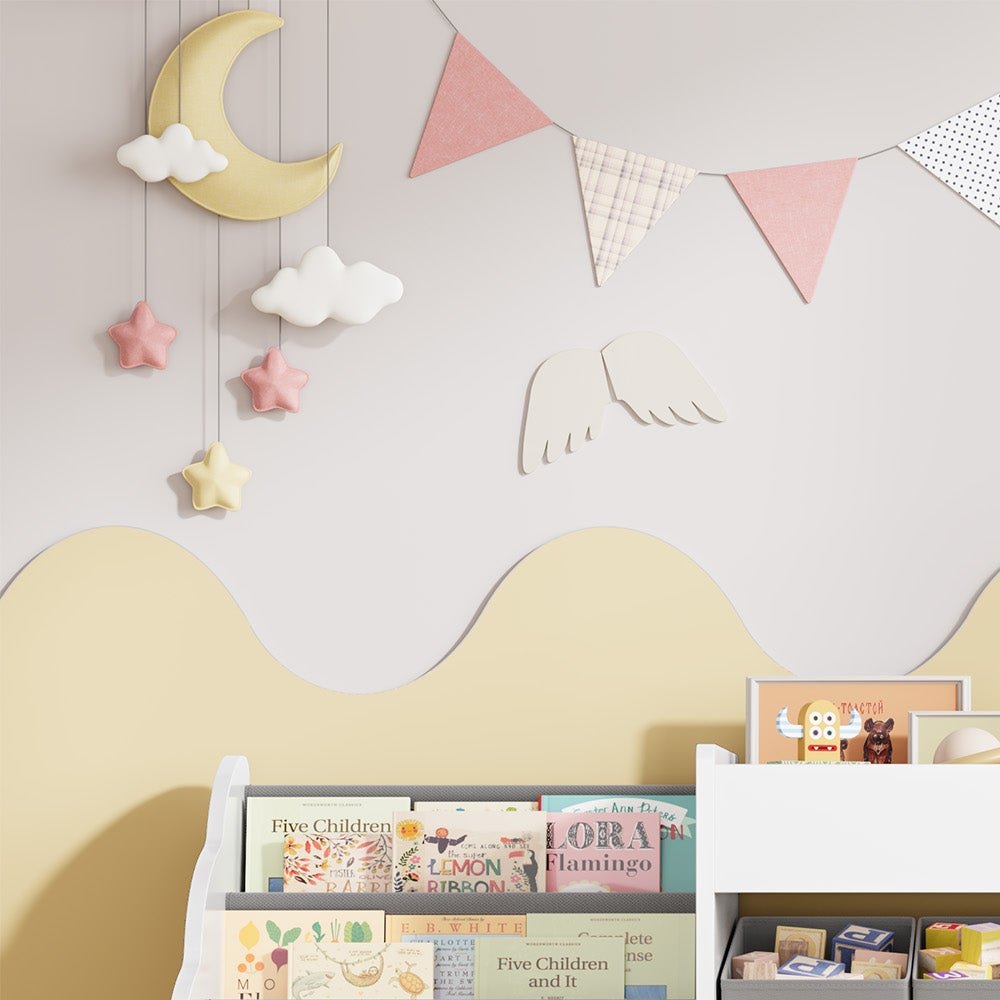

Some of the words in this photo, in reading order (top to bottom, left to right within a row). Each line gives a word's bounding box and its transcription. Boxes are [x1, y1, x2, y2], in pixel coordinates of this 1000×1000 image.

[271, 819, 308, 833] Five
[313, 818, 391, 833] Children
[427, 859, 502, 876] LEMON
[546, 853, 652, 877] Flamingo
[427, 880, 505, 893] RIBBON
[401, 923, 416, 933] E.
[426, 923, 441, 933] B.
[450, 923, 523, 933] WHITE
[496, 957, 532, 971] Five
[536, 957, 609, 971] Children
[528, 975, 561, 988] and
[565, 975, 577, 988] It
